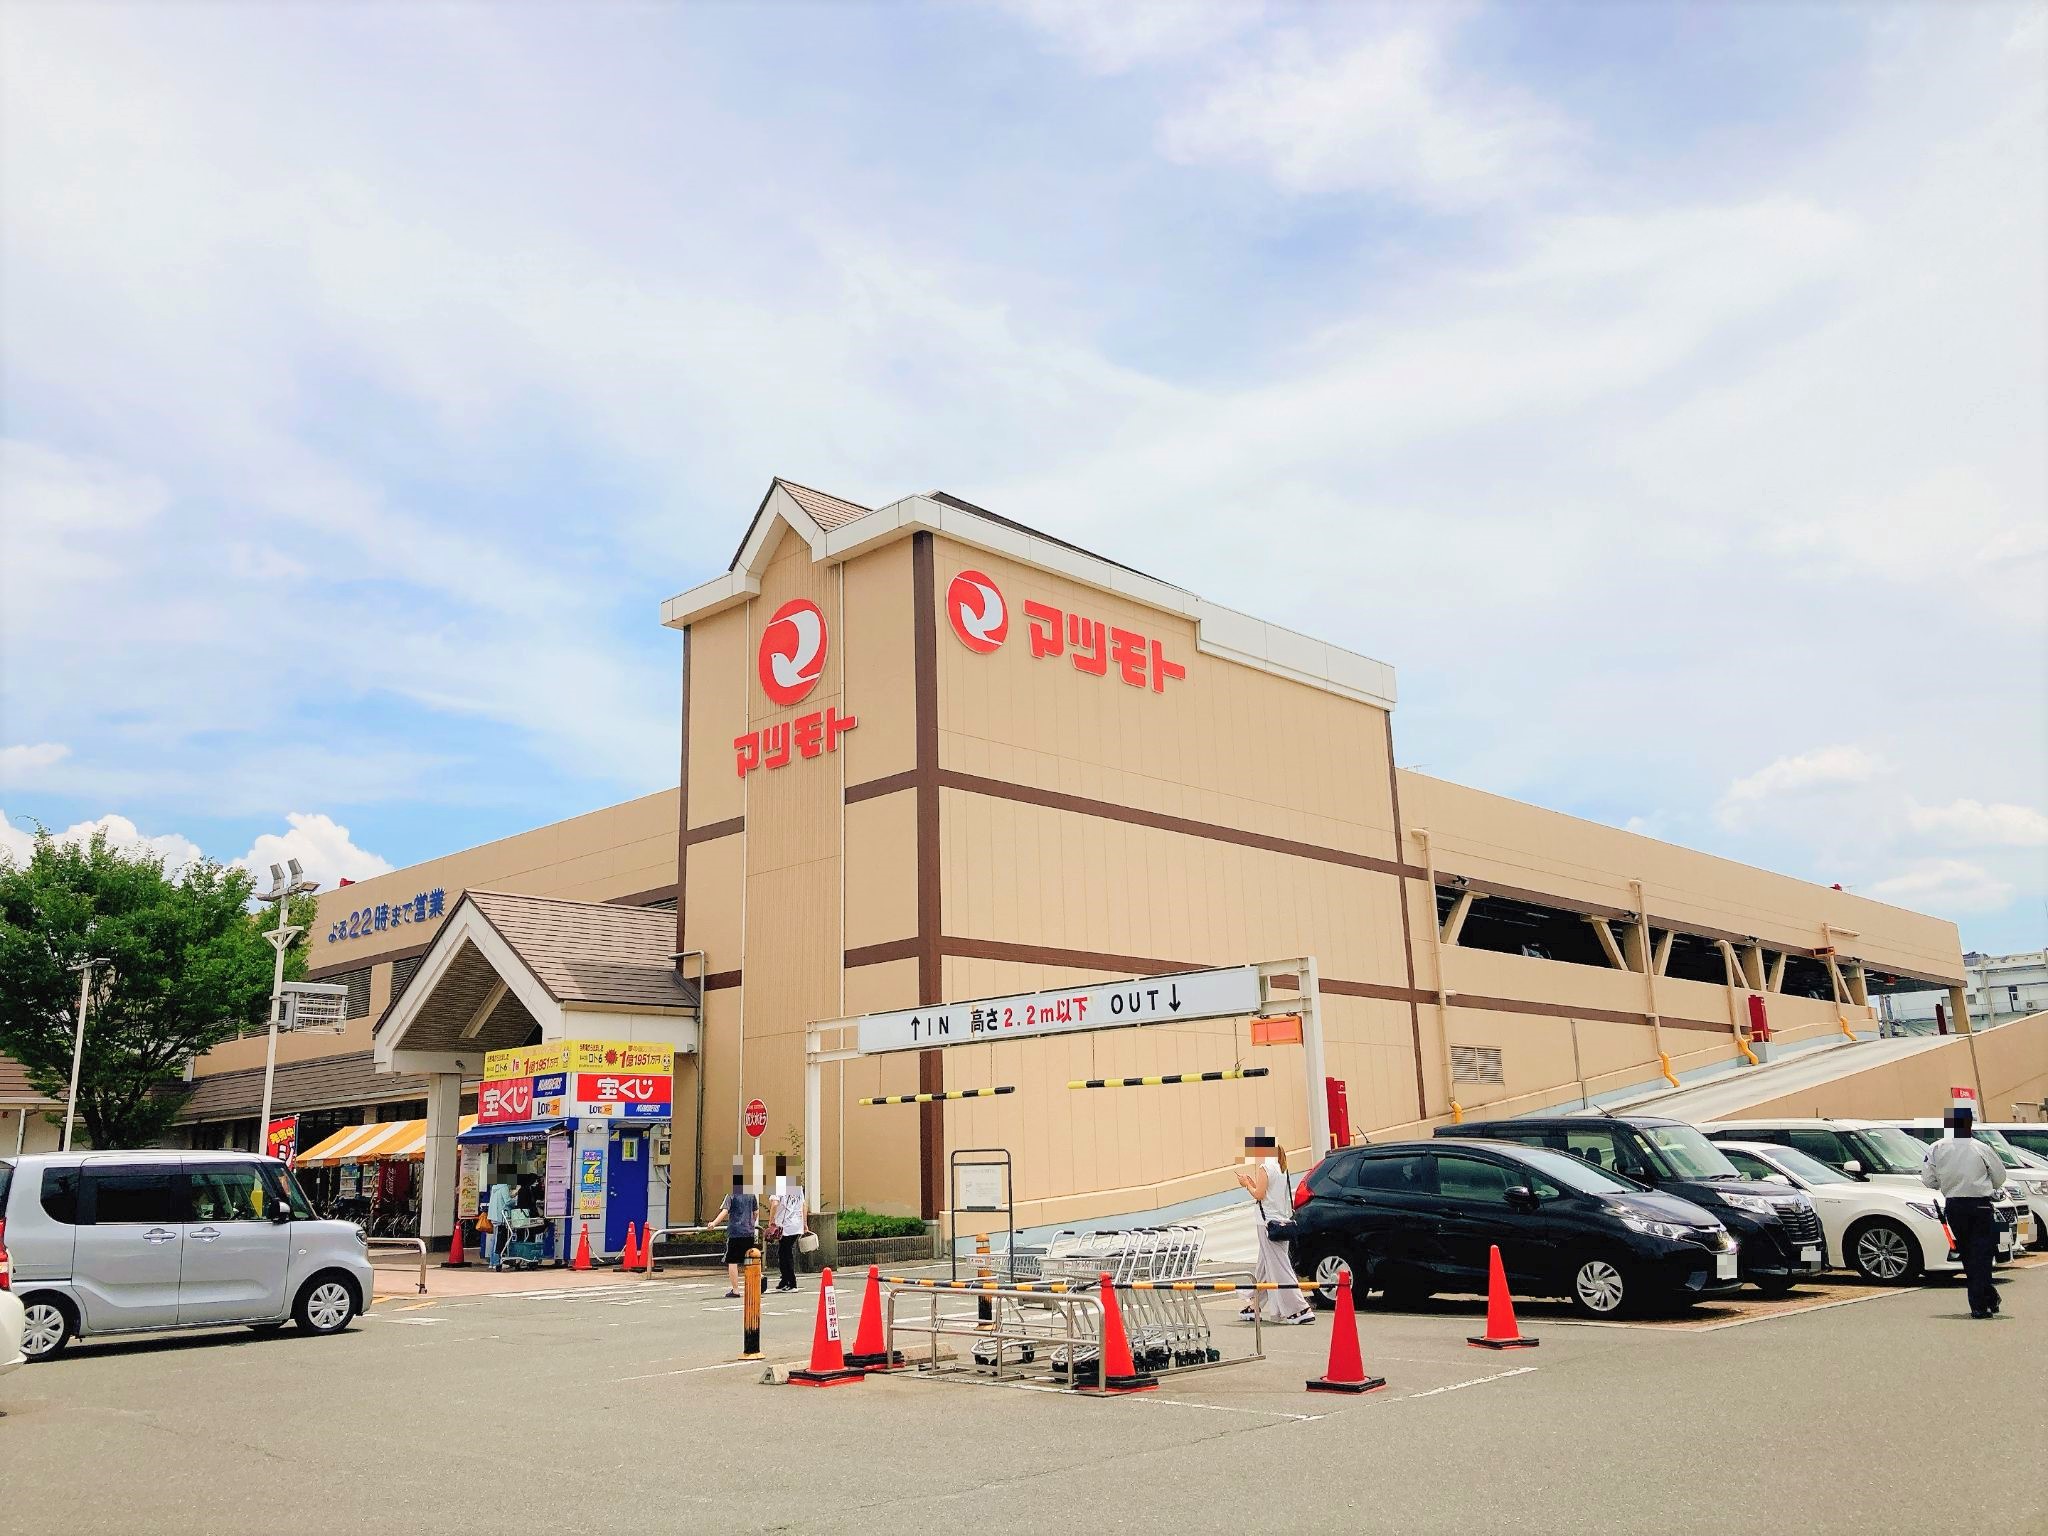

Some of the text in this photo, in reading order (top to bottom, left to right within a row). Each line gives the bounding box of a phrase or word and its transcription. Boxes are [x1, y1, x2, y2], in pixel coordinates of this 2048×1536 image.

[1023, 599, 1186, 694] マツモト
[733, 706, 859, 778] マツモト
[328, 888, 446, 944] よる22時まで営業
[927, 989, 1159, 1036] IN 高さ2.2m以下 OUT
[482, 1086, 528, 1117] 宝くじ
[597, 1077, 654, 1100] 宝くじ
[827, 1295, 839, 1339] 駐車禁止
